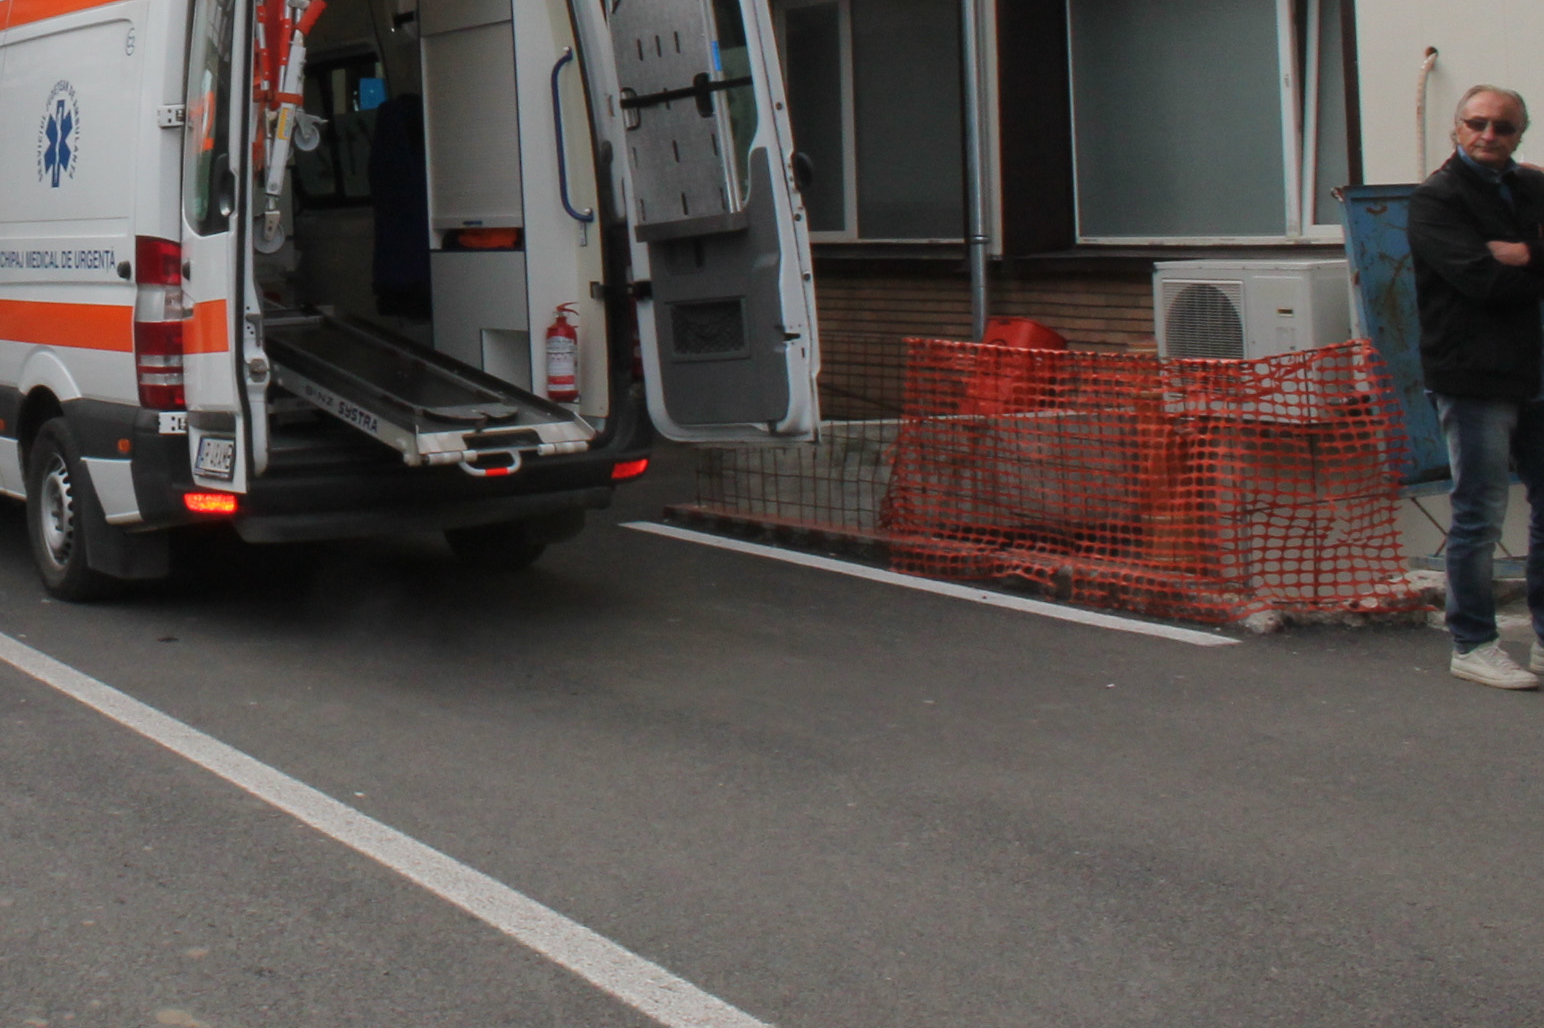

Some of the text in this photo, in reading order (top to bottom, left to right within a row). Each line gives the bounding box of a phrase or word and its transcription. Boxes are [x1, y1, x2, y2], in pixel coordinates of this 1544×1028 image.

[26, 250, 59, 269] MEDICAL
[61, 250, 73, 269] DE
[338, 401, 378, 433] SYSTRA
